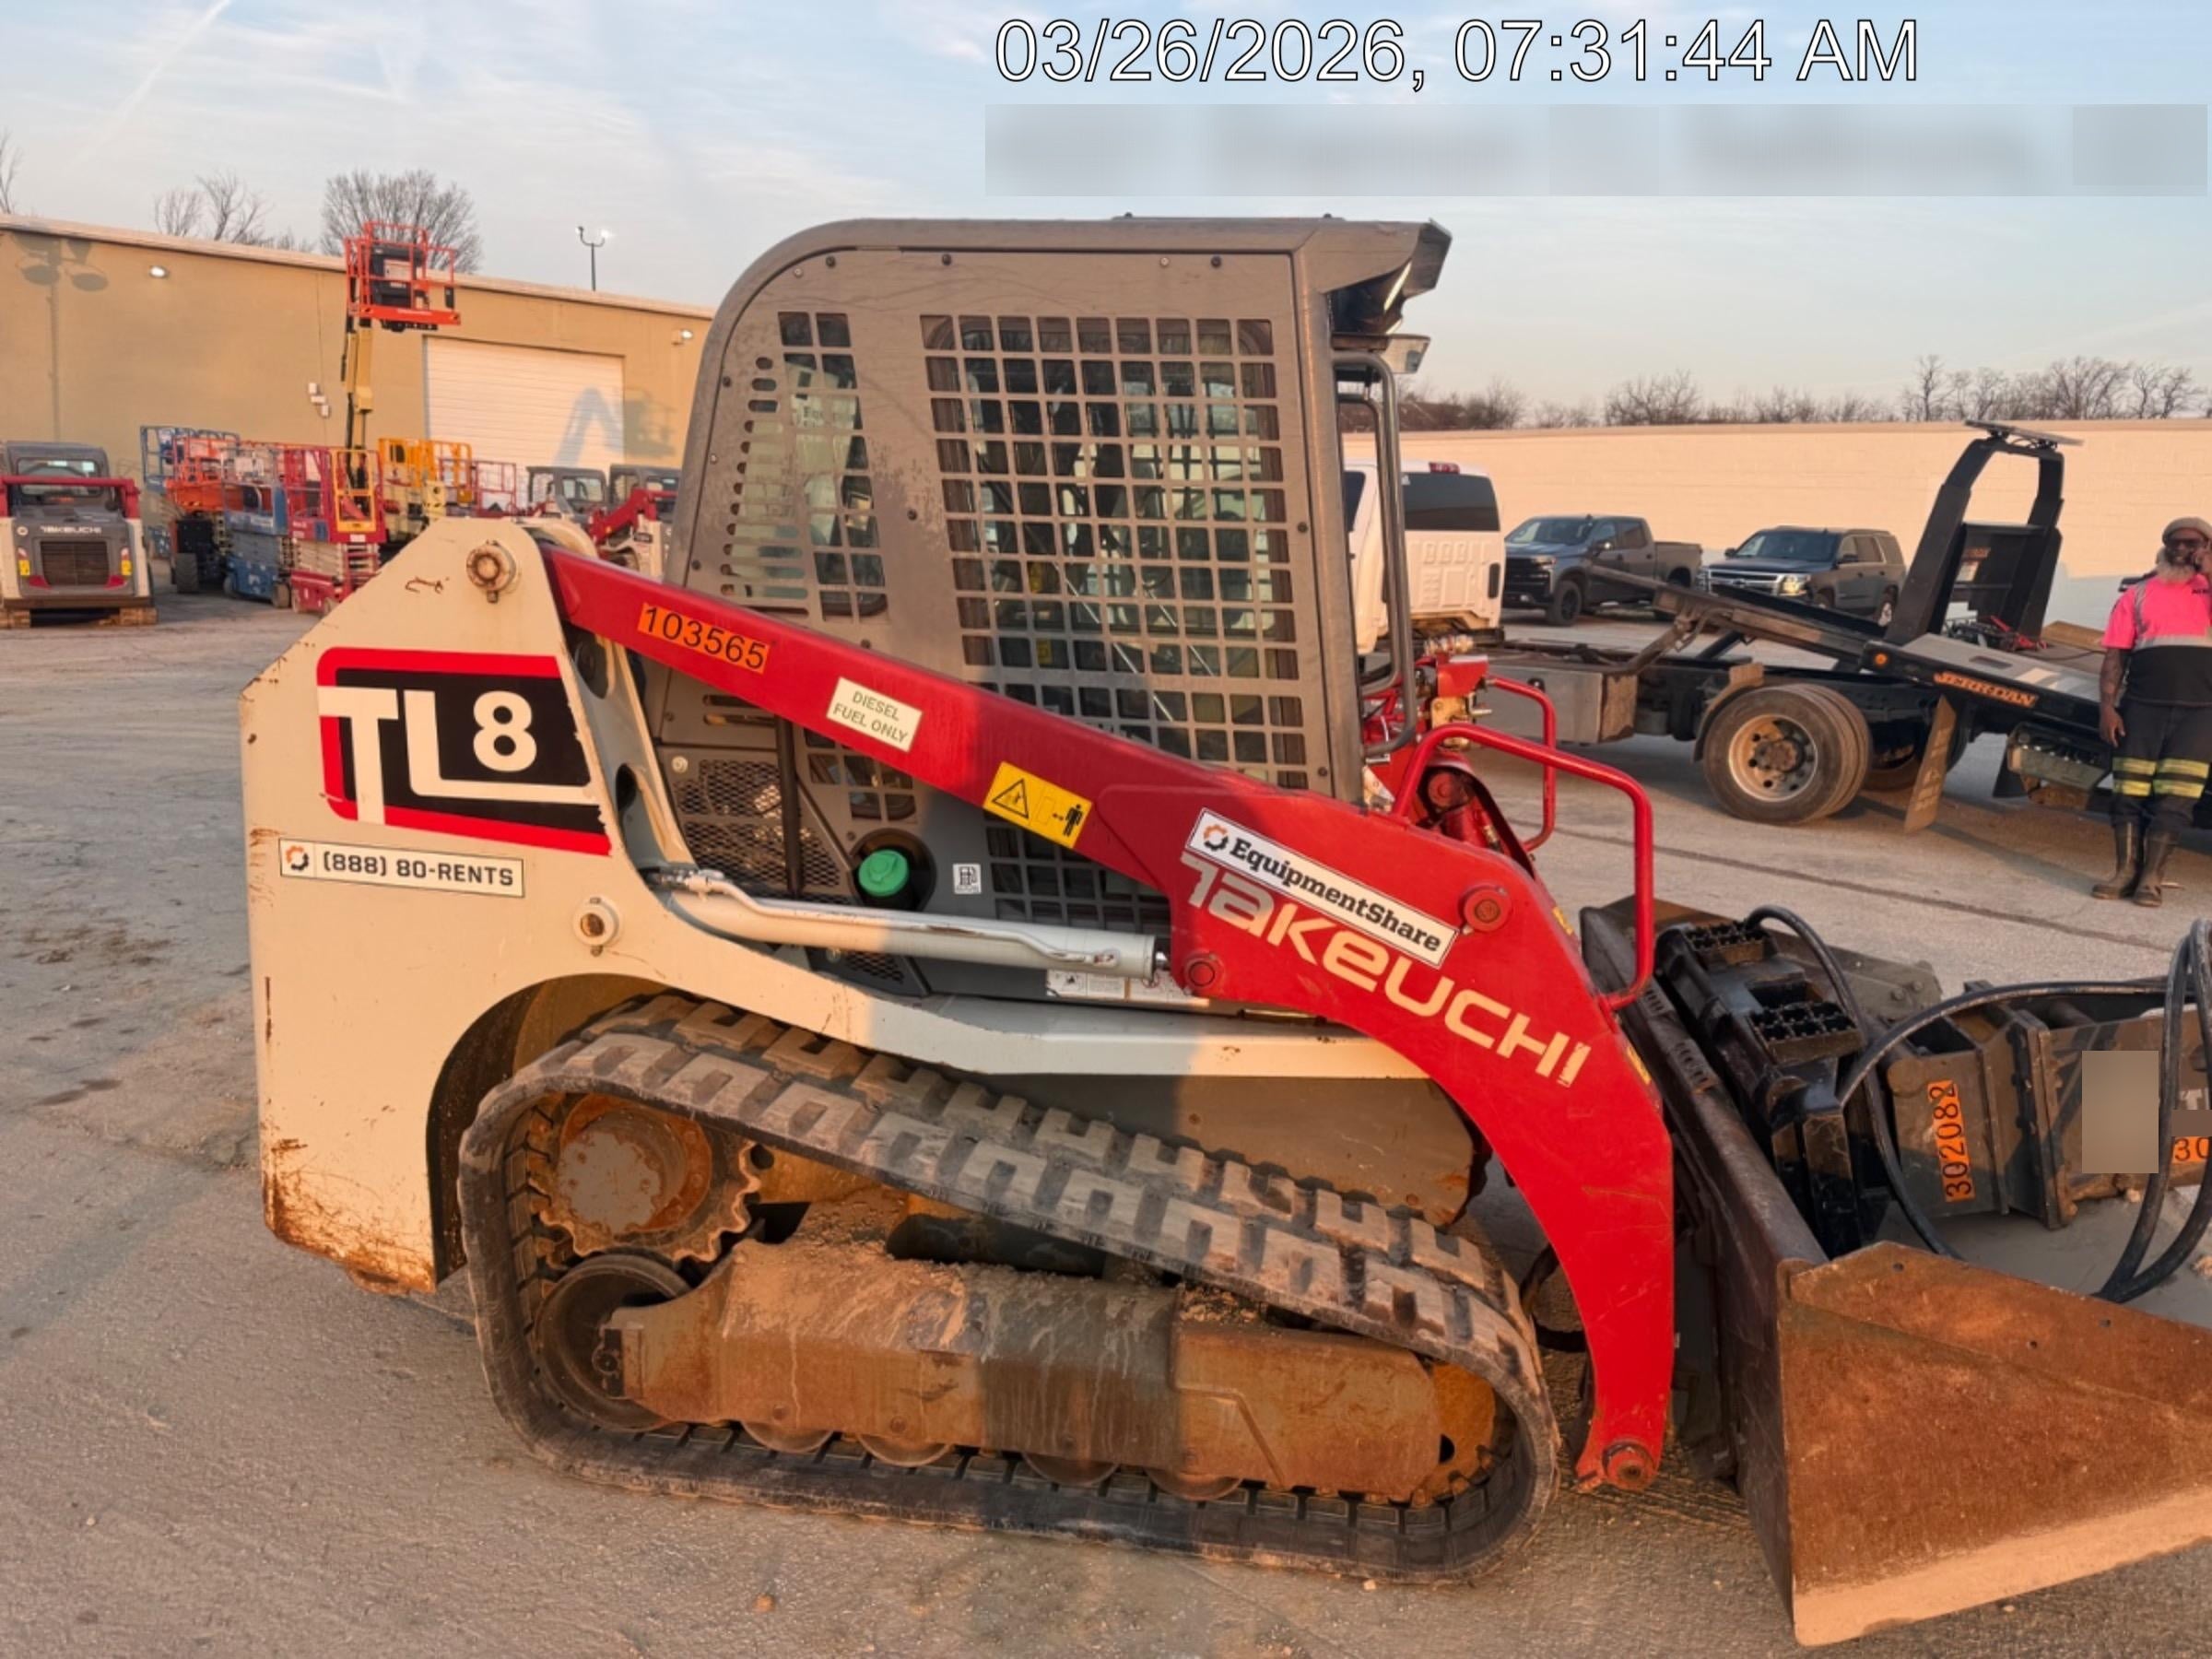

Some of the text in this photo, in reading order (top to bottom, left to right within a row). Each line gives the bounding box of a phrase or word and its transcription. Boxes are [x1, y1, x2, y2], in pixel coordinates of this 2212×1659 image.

[645, 606, 766, 670] 103565
[832, 702, 909, 743] FUEL ONLY
[852, 690, 900, 722] DIESEL
[317, 685, 599, 826] TL8
[323, 850, 514, 887] (888) 80-RENTS
[1230, 836, 1442, 953] EquipmentShare
[1928, 1083, 1972, 1198] 302082
